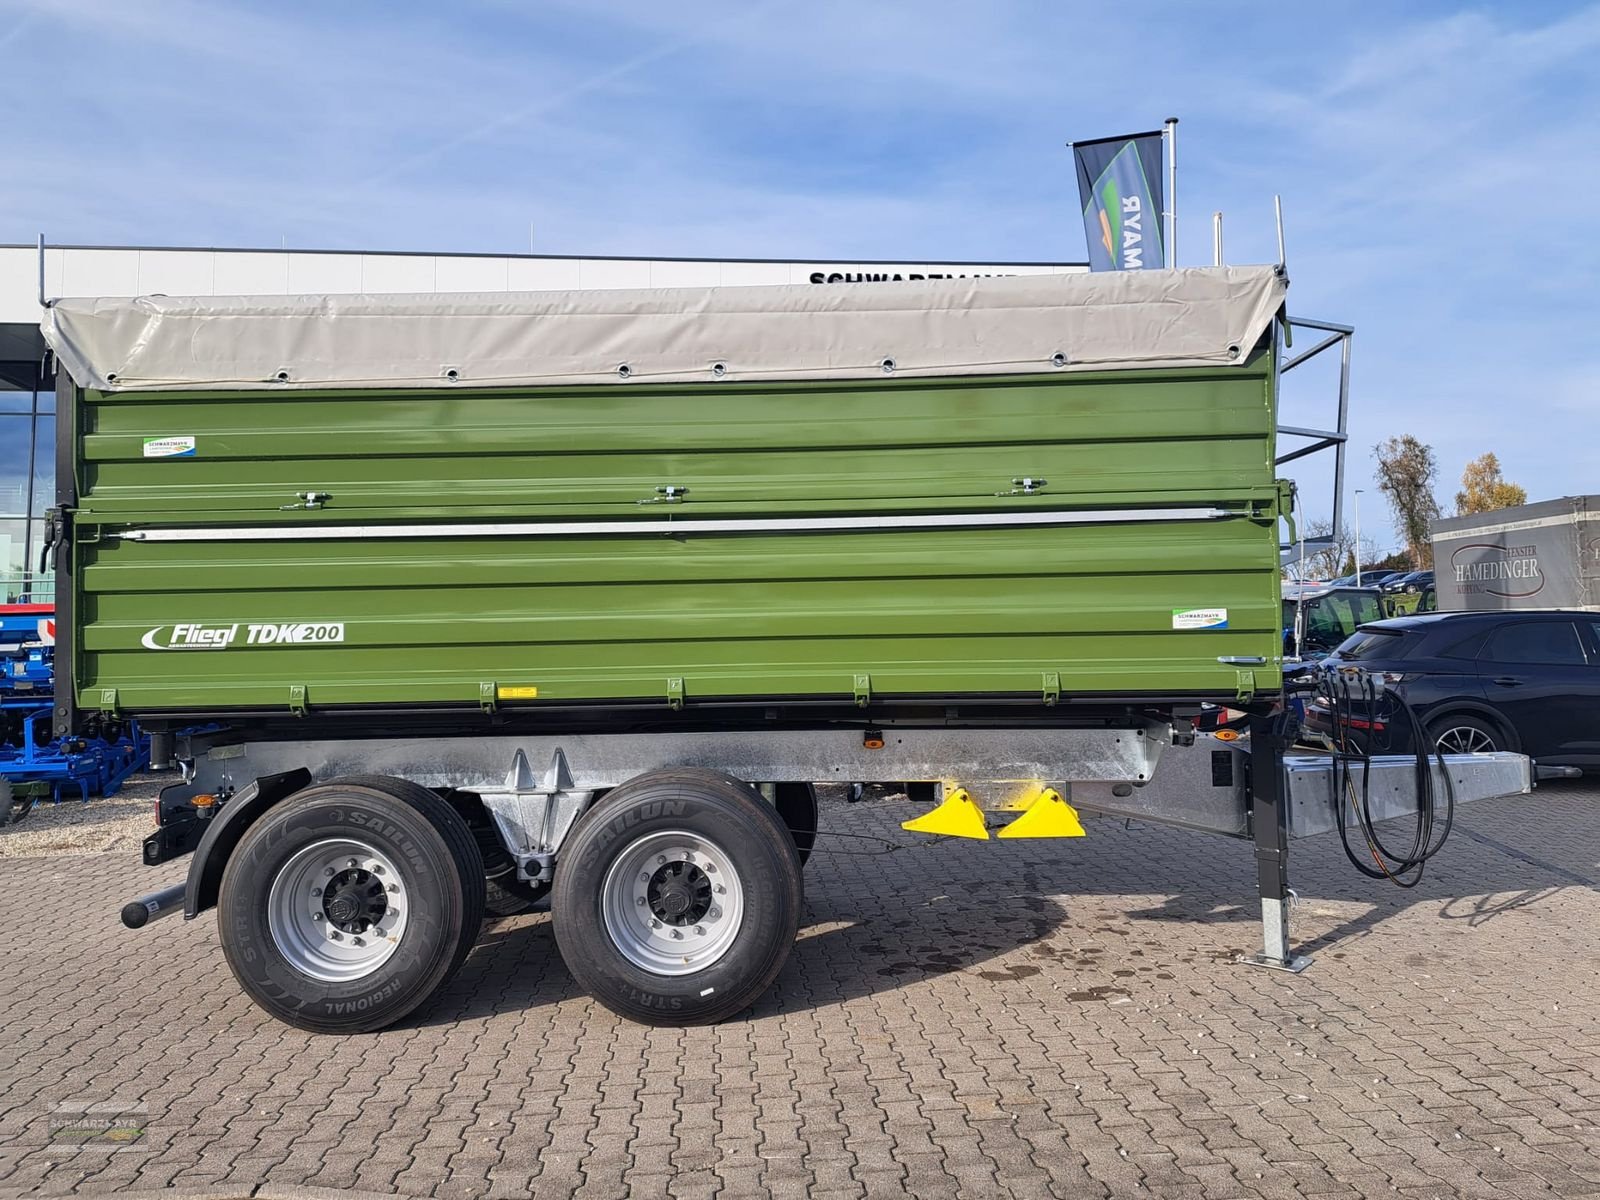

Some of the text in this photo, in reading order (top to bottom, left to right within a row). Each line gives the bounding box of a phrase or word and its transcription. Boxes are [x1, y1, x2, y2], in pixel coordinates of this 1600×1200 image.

[1507, 545, 1537, 558] FENSTER
[1456, 559, 1538, 581] HAMEDINGER
[171, 624, 340, 647] Fliegl TDK 200
[348, 811, 428, 873] SAILUN
[582, 801, 686, 869] SAILUN
[325, 978, 402, 1015] REGIONAL
